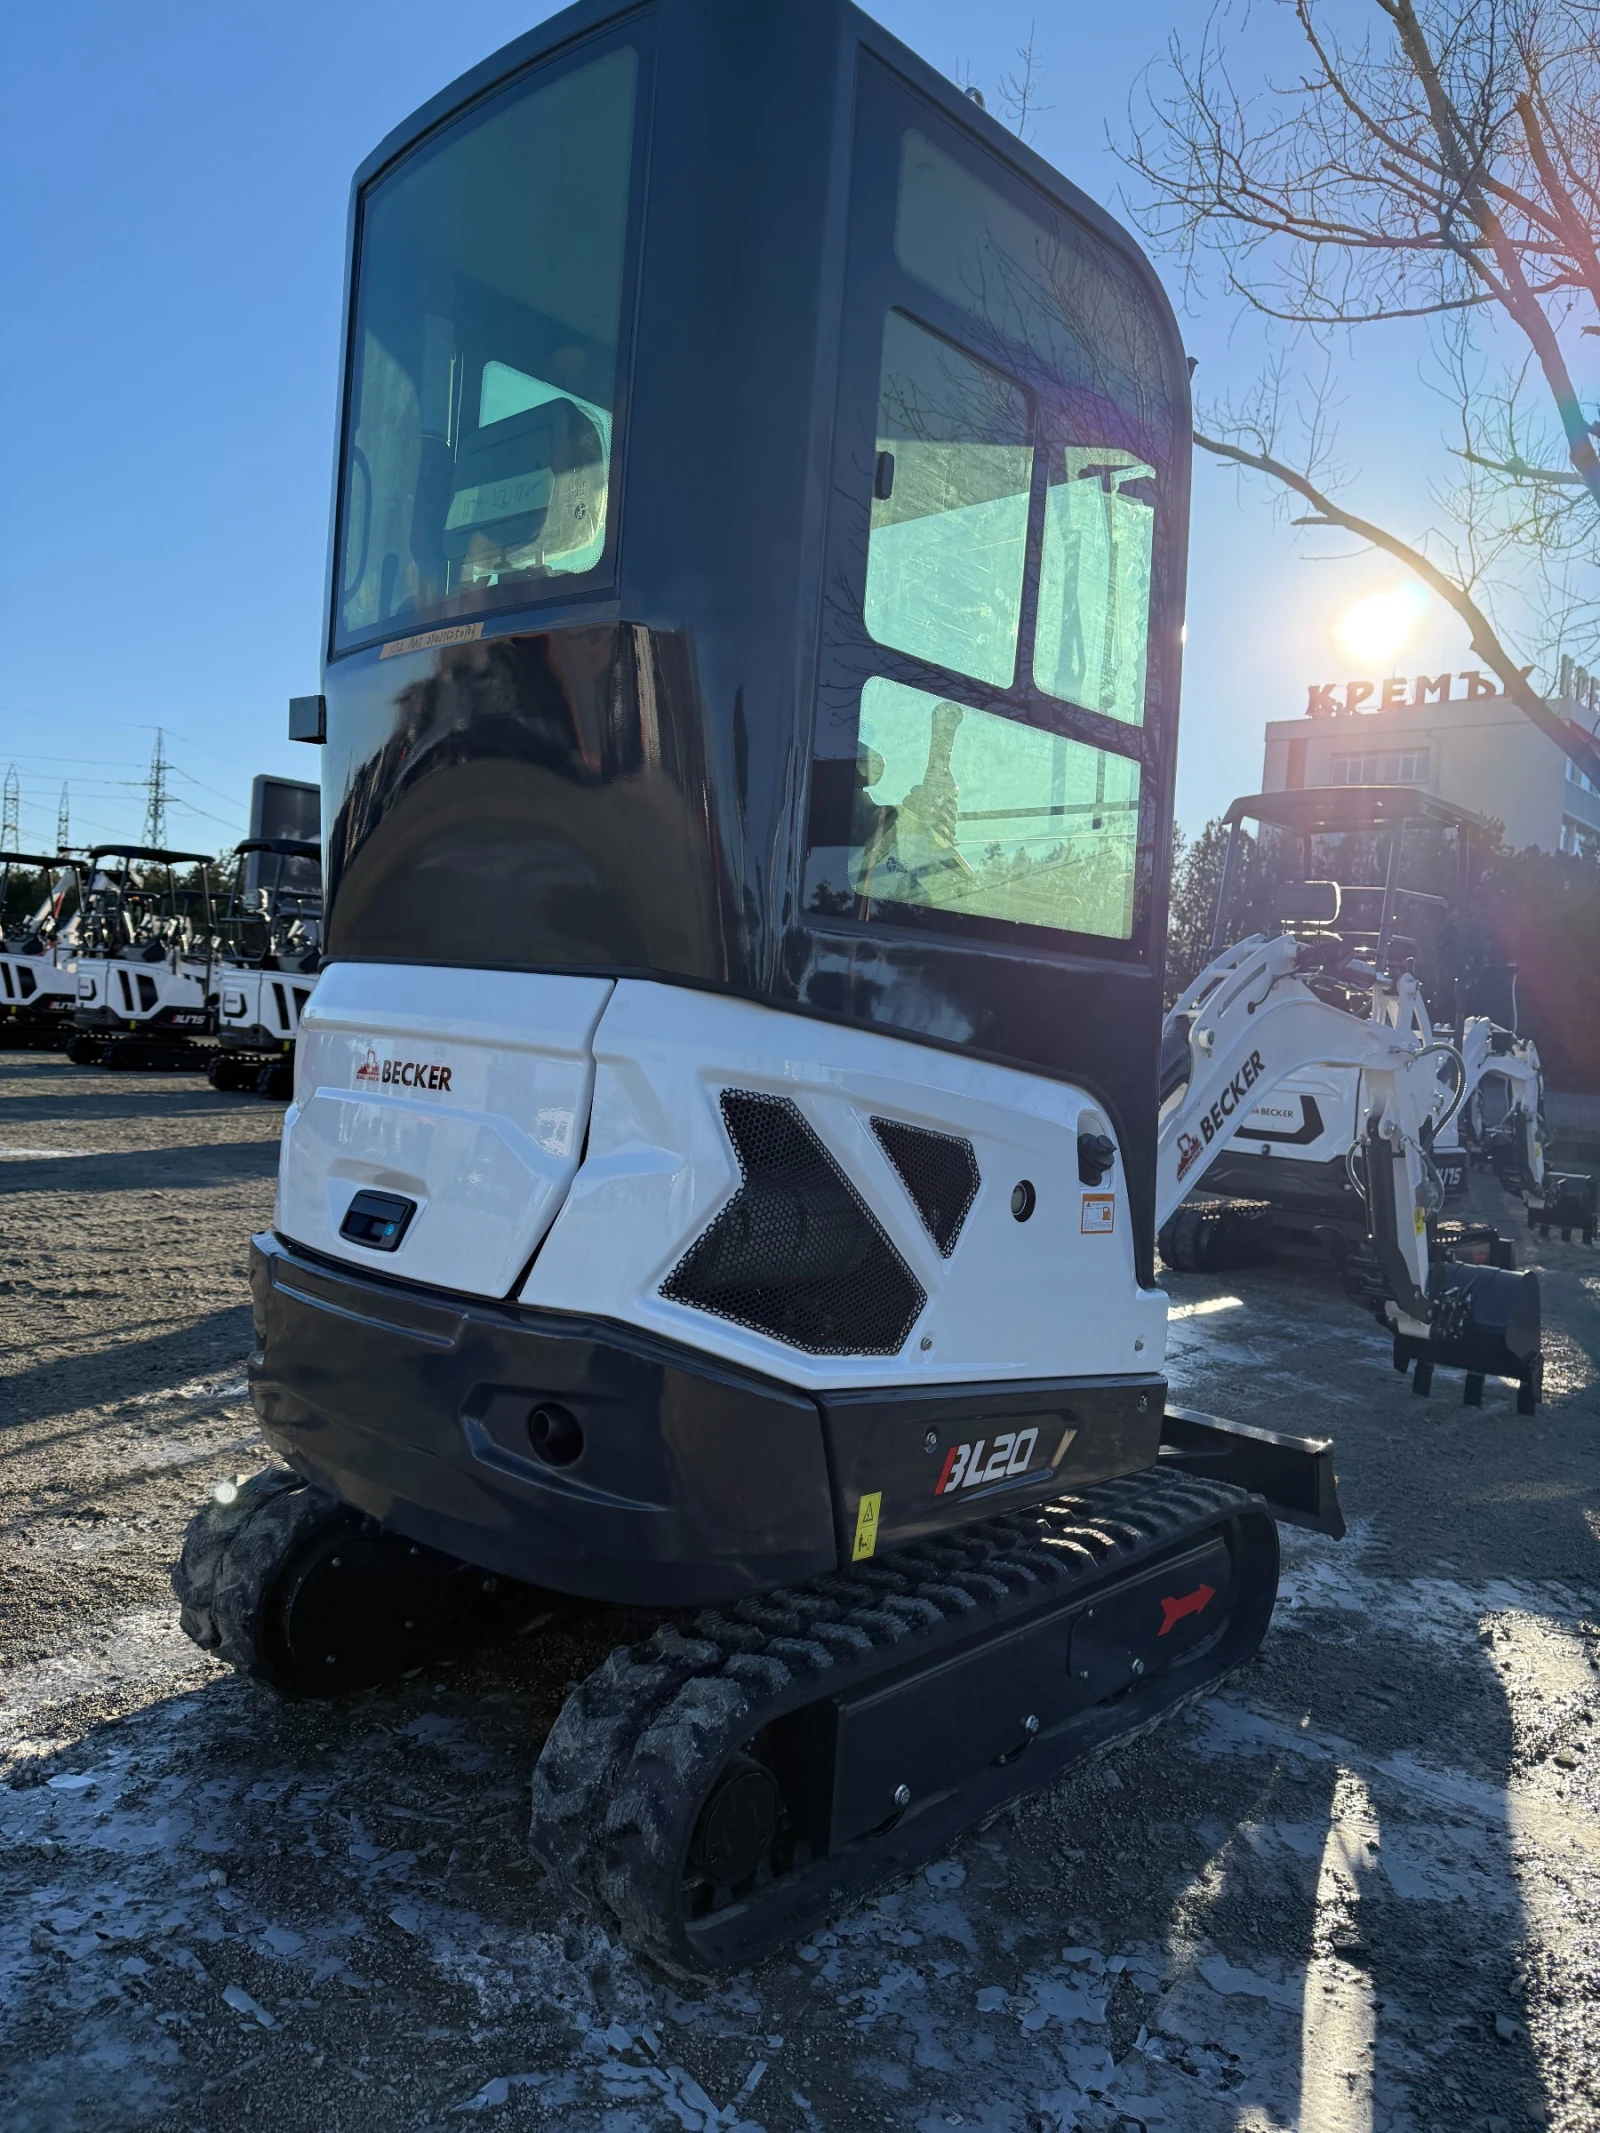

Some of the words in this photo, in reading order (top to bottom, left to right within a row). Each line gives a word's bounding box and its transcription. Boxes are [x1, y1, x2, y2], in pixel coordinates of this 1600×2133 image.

[382, 1060, 452, 1092] BECKER
[1200, 1050, 1266, 1145] BECKER
[1260, 1107, 1294, 1118] BECKER
[934, 1426, 1039, 1495] BL20
